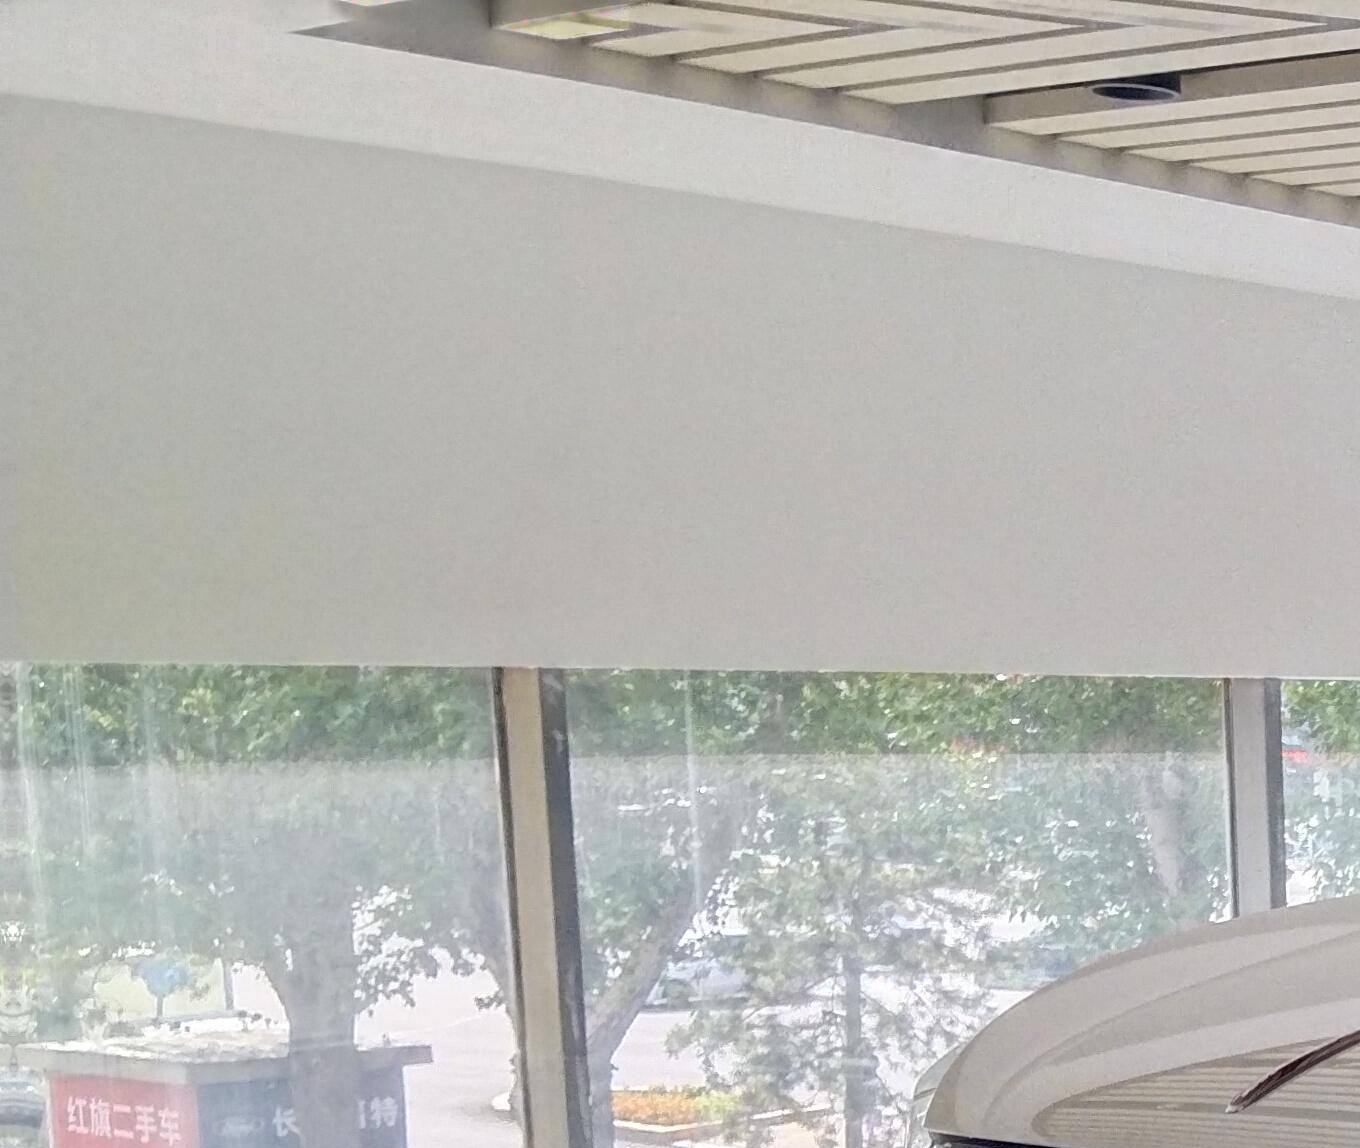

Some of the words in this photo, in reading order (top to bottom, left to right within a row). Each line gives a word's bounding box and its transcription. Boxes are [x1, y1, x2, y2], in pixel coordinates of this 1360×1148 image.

[67, 1096, 181, 1146] 红旗二手车
